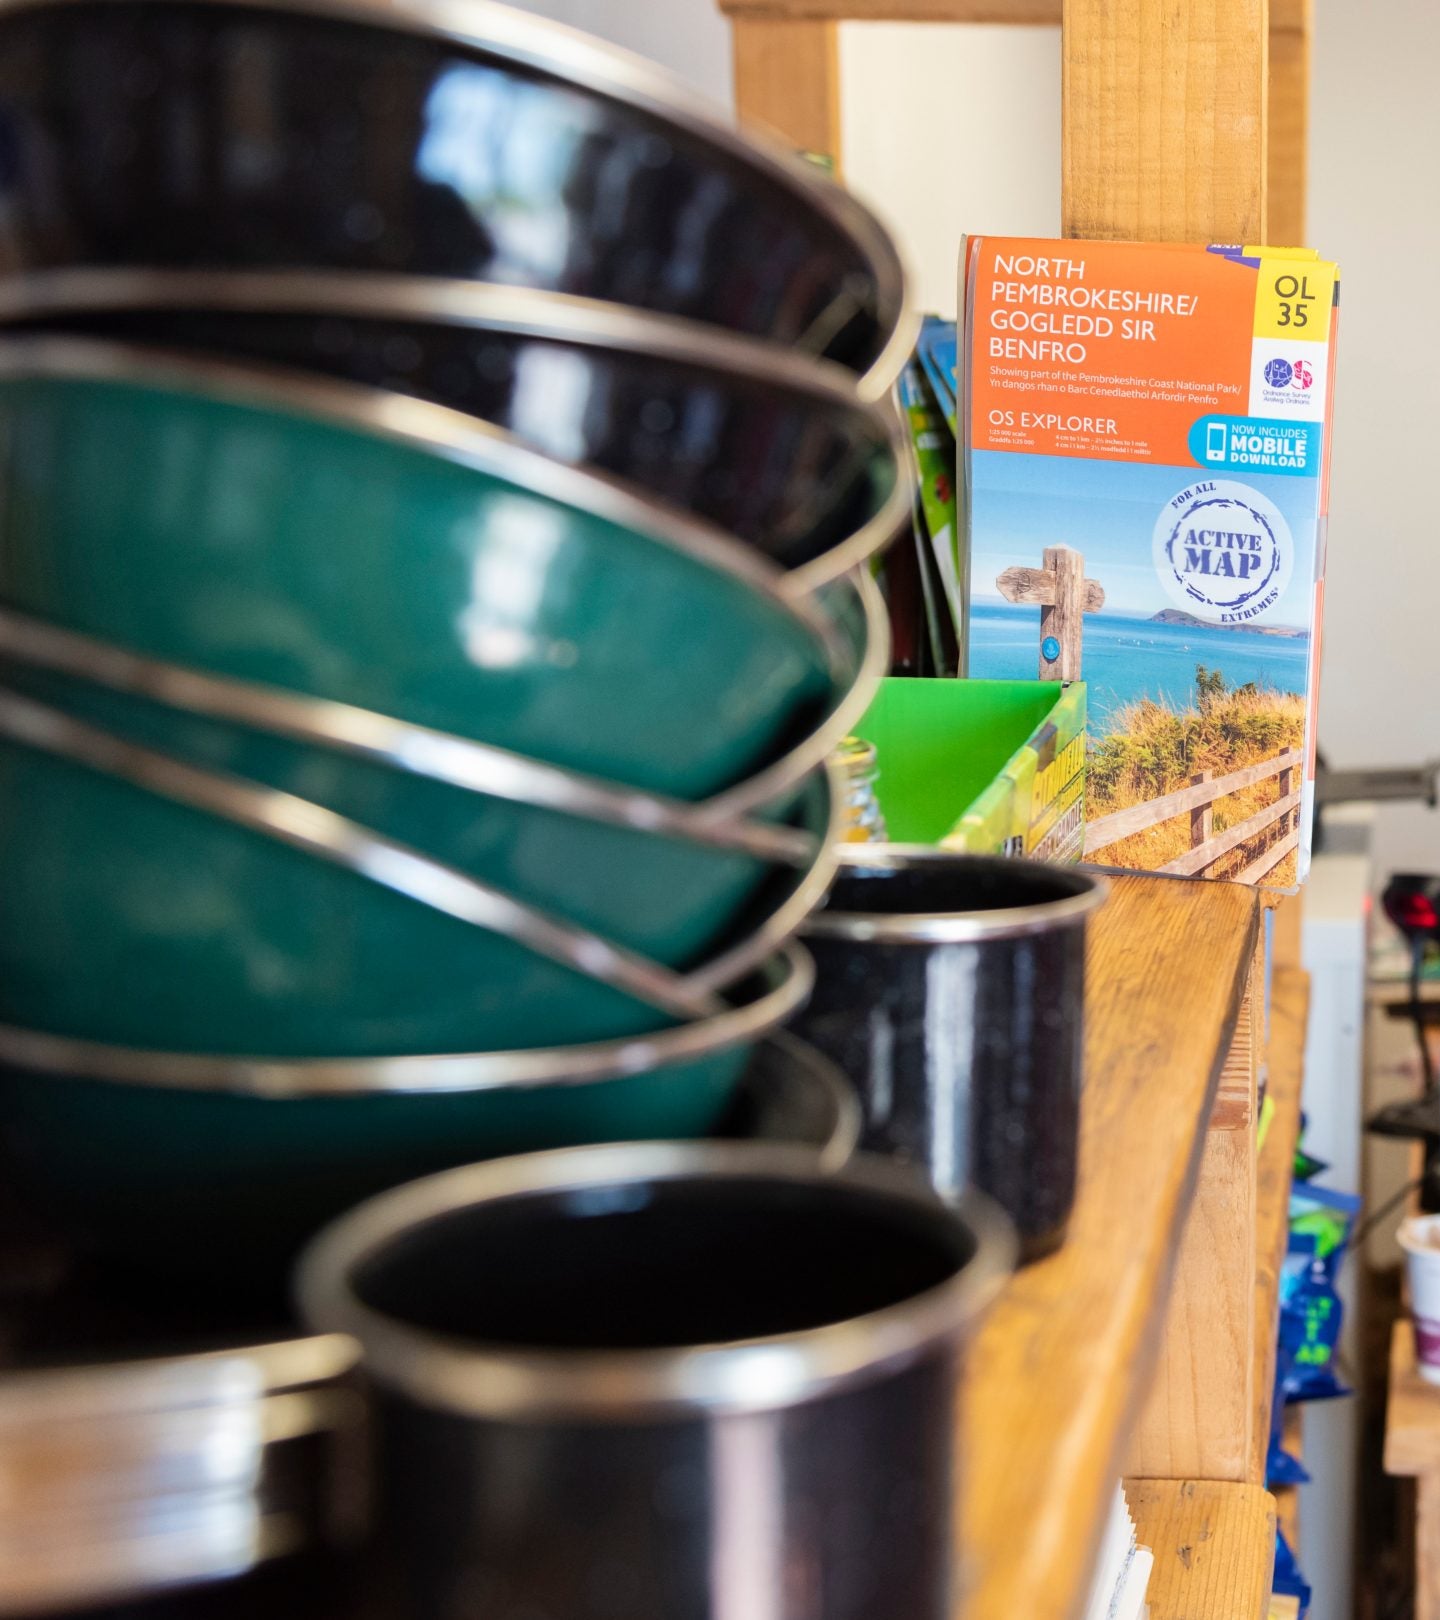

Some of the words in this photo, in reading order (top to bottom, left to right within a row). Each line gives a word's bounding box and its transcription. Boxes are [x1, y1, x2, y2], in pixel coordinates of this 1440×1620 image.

[993, 254, 1086, 280] NORTH
[991, 281, 1198, 316] PEMBROKESHIRE/
[1274, 275, 1315, 300] OL
[990, 309, 1114, 338] GOGLEDD
[1121, 319, 1157, 342] SIR
[1277, 302, 1308, 327] 35
[989, 337, 1087, 364] BENFRO
[989, 366, 1029, 380] Showing
[1031, 369, 1049, 382] part
[1051, 370, 1061, 380] of
[1062, 371, 1077, 381] the
[1079, 372, 1148, 388] Pembrokeshire
[1149, 378, 1175, 389] Coast
[1176, 380, 1215, 393] National
[1216, 383, 1243, 396] Park/
[989, 379, 1001, 388] Yn
[1002, 380, 1036, 392] dangos
[1037, 382, 1058, 392] rhan
[1059, 385, 1066, 393] o
[1067, 384, 1088, 395] Barc
[1089, 385, 1150, 400] Cenedlaethol
[1151, 390, 1186, 403] Arfordir
[1188, 393, 1219, 405] Penfro
[988, 409, 1015, 426] OS
[1020, 412, 1118, 435] EXPLORER
[1231, 423, 1255, 436] NOW
[1258, 425, 1308, 439] INCLUDES
[1230, 434, 1307, 457] MOBILE
[1230, 451, 1306, 469] DOWNLOAD
[1171, 490, 1194, 509] FOR
[1195, 482, 1217, 495] ALL
[1183, 529, 1262, 552] ACTIVE
[1183, 547, 1261, 579] MAP
